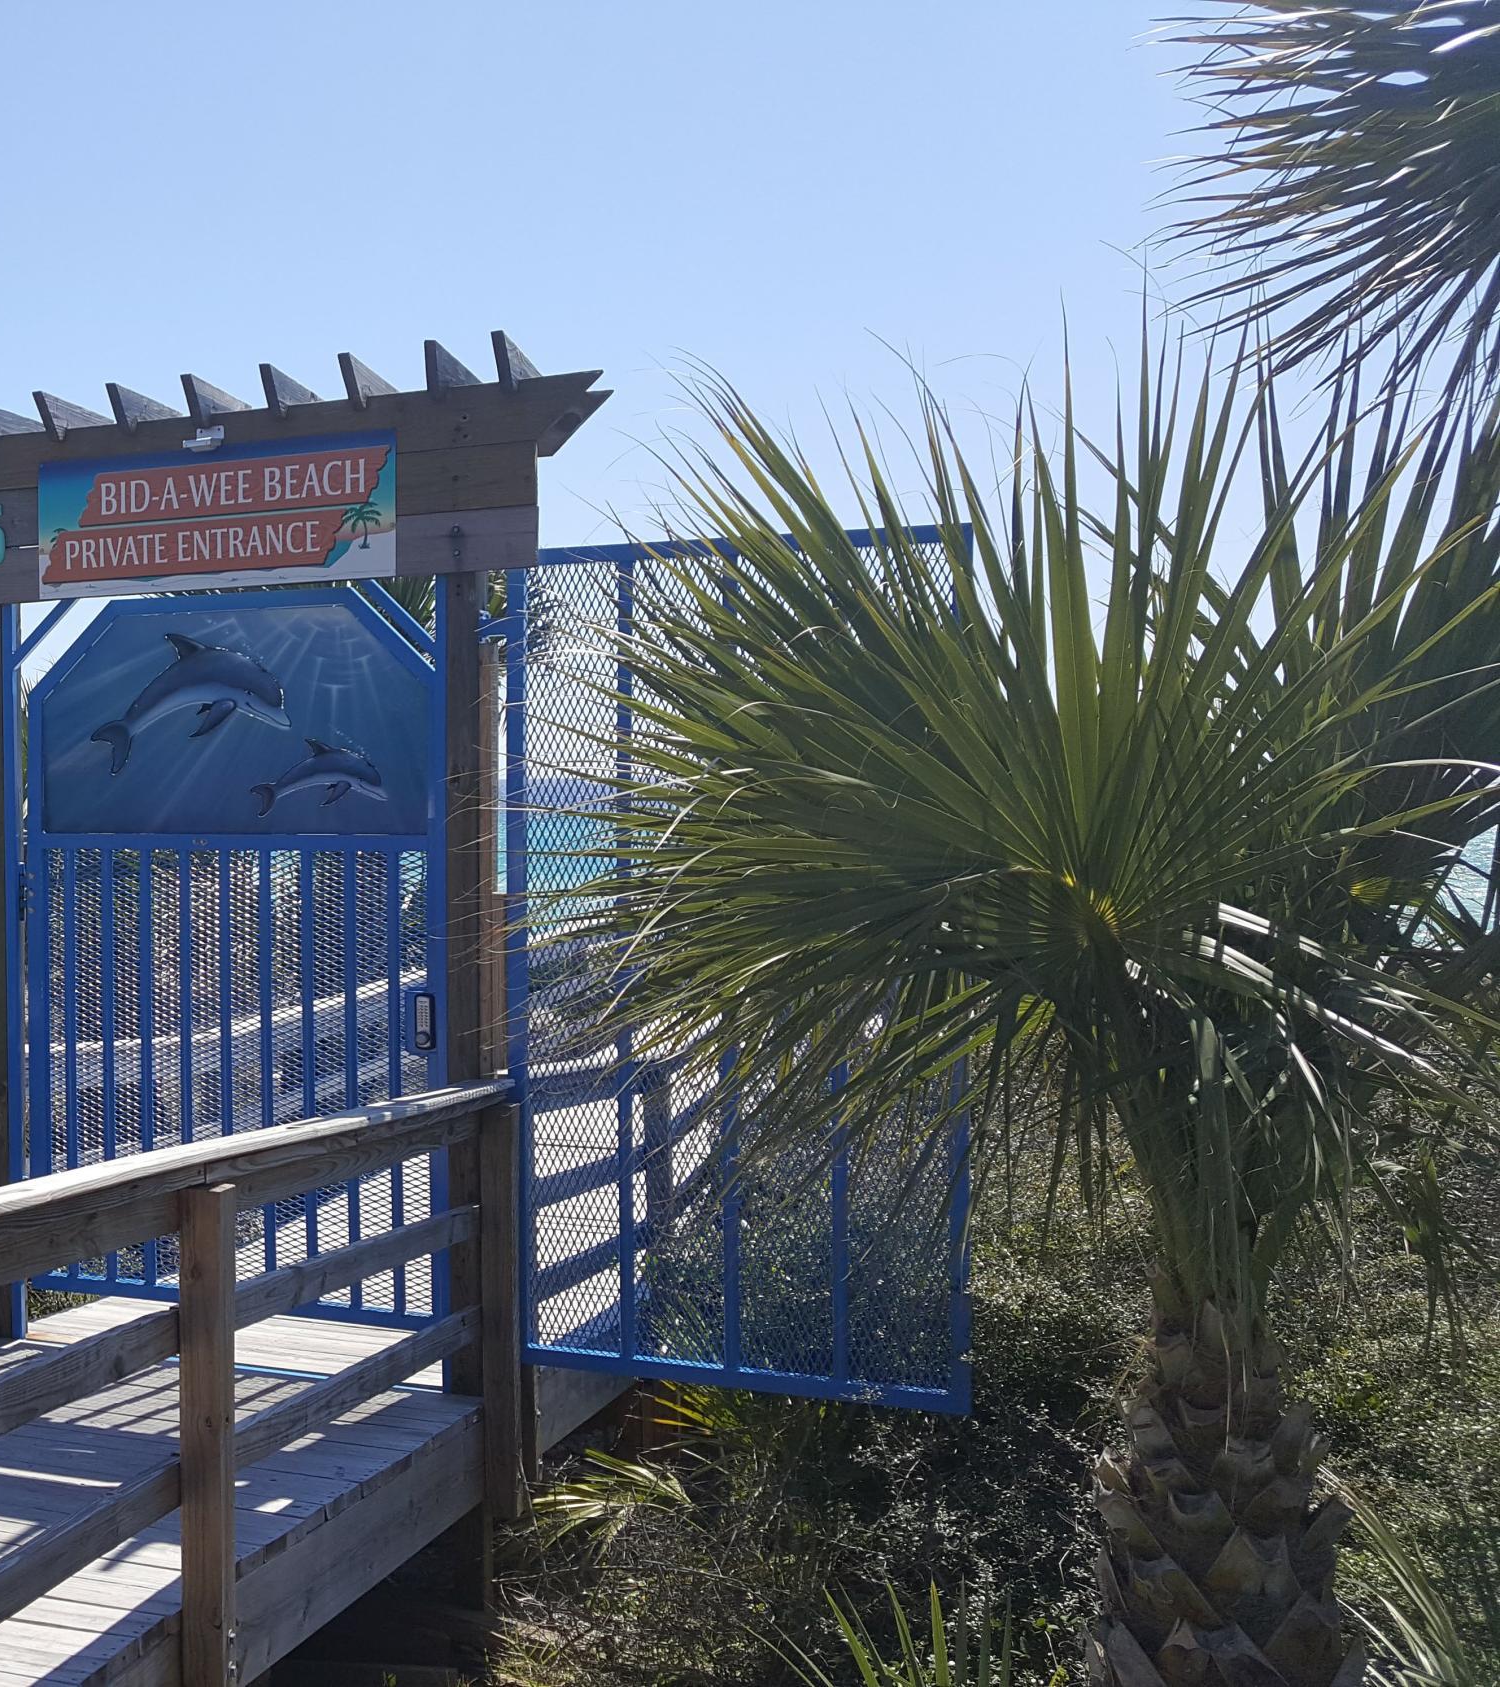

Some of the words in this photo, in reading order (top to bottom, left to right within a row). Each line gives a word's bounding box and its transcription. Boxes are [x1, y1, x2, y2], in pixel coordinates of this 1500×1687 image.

[100, 469, 253, 516] BID-A-WEE
[263, 458, 366, 502] BEACH
[65, 532, 168, 570] PRIVATE
[177, 520, 321, 563] ENTRANCE
